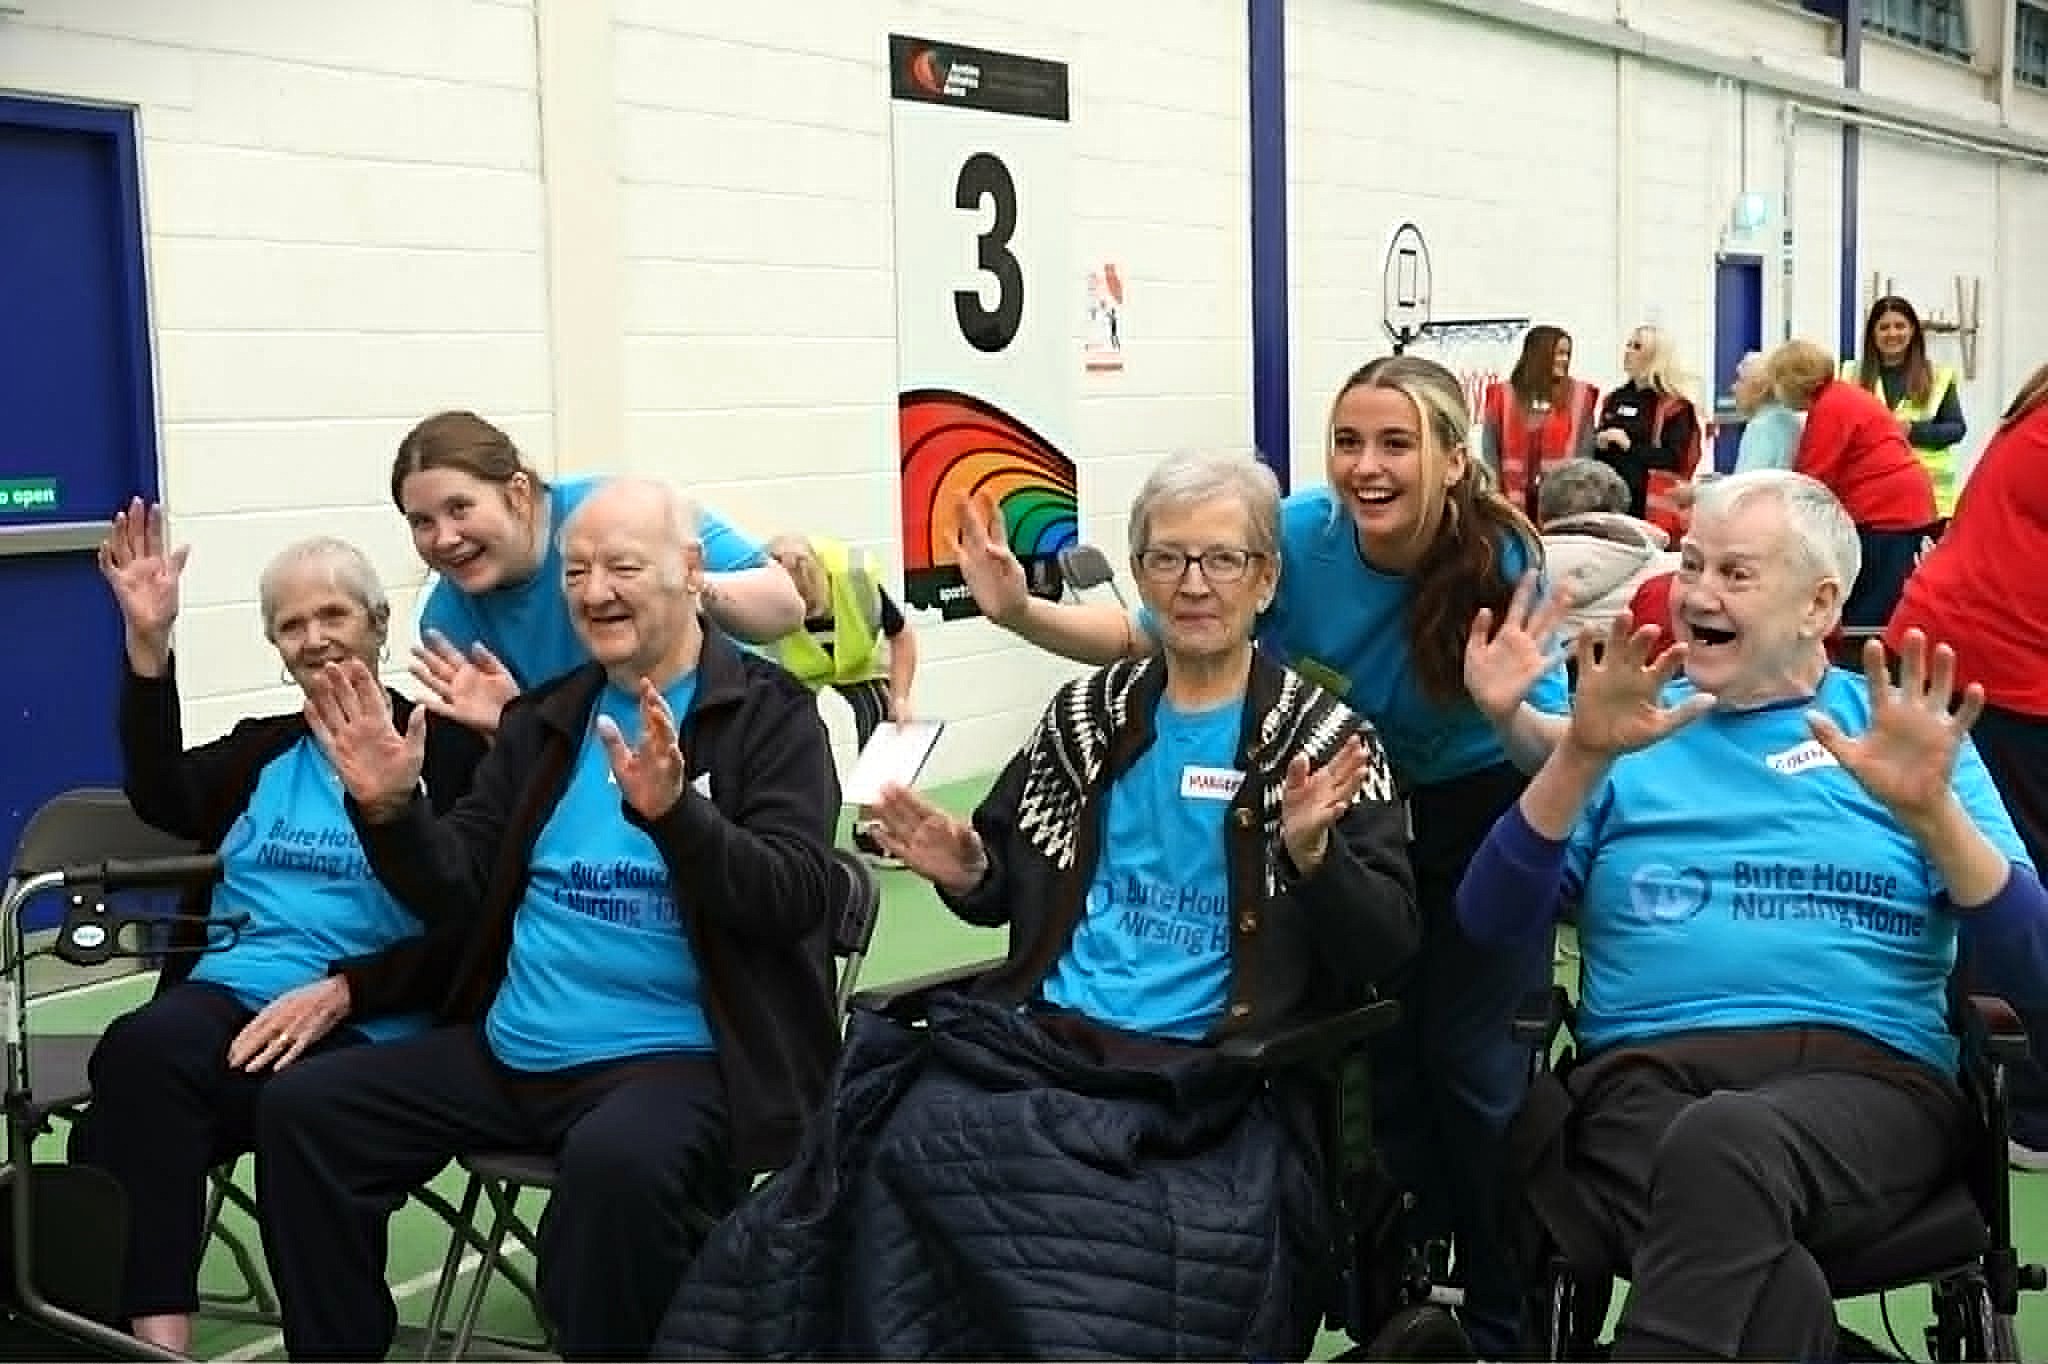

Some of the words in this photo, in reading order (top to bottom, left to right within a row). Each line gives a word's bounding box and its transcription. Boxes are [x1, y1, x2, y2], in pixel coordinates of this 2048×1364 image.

[954, 151, 1024, 353] 3
[13, 489, 54, 510] open
[268, 815, 316, 848] Bute
[256, 842, 342, 878] Nursing
[571, 860, 612, 891] Bute
[1127, 874, 1176, 913] Bute
[1178, 886, 1227, 914] Hou
[1733, 860, 1806, 890] Bute
[1812, 863, 1898, 900] House
[567, 890, 642, 926] Nursing
[1732, 892, 1857, 929] Nursing
[1856, 902, 1926, 937] Home
[1119, 910, 1204, 955] Nursing
